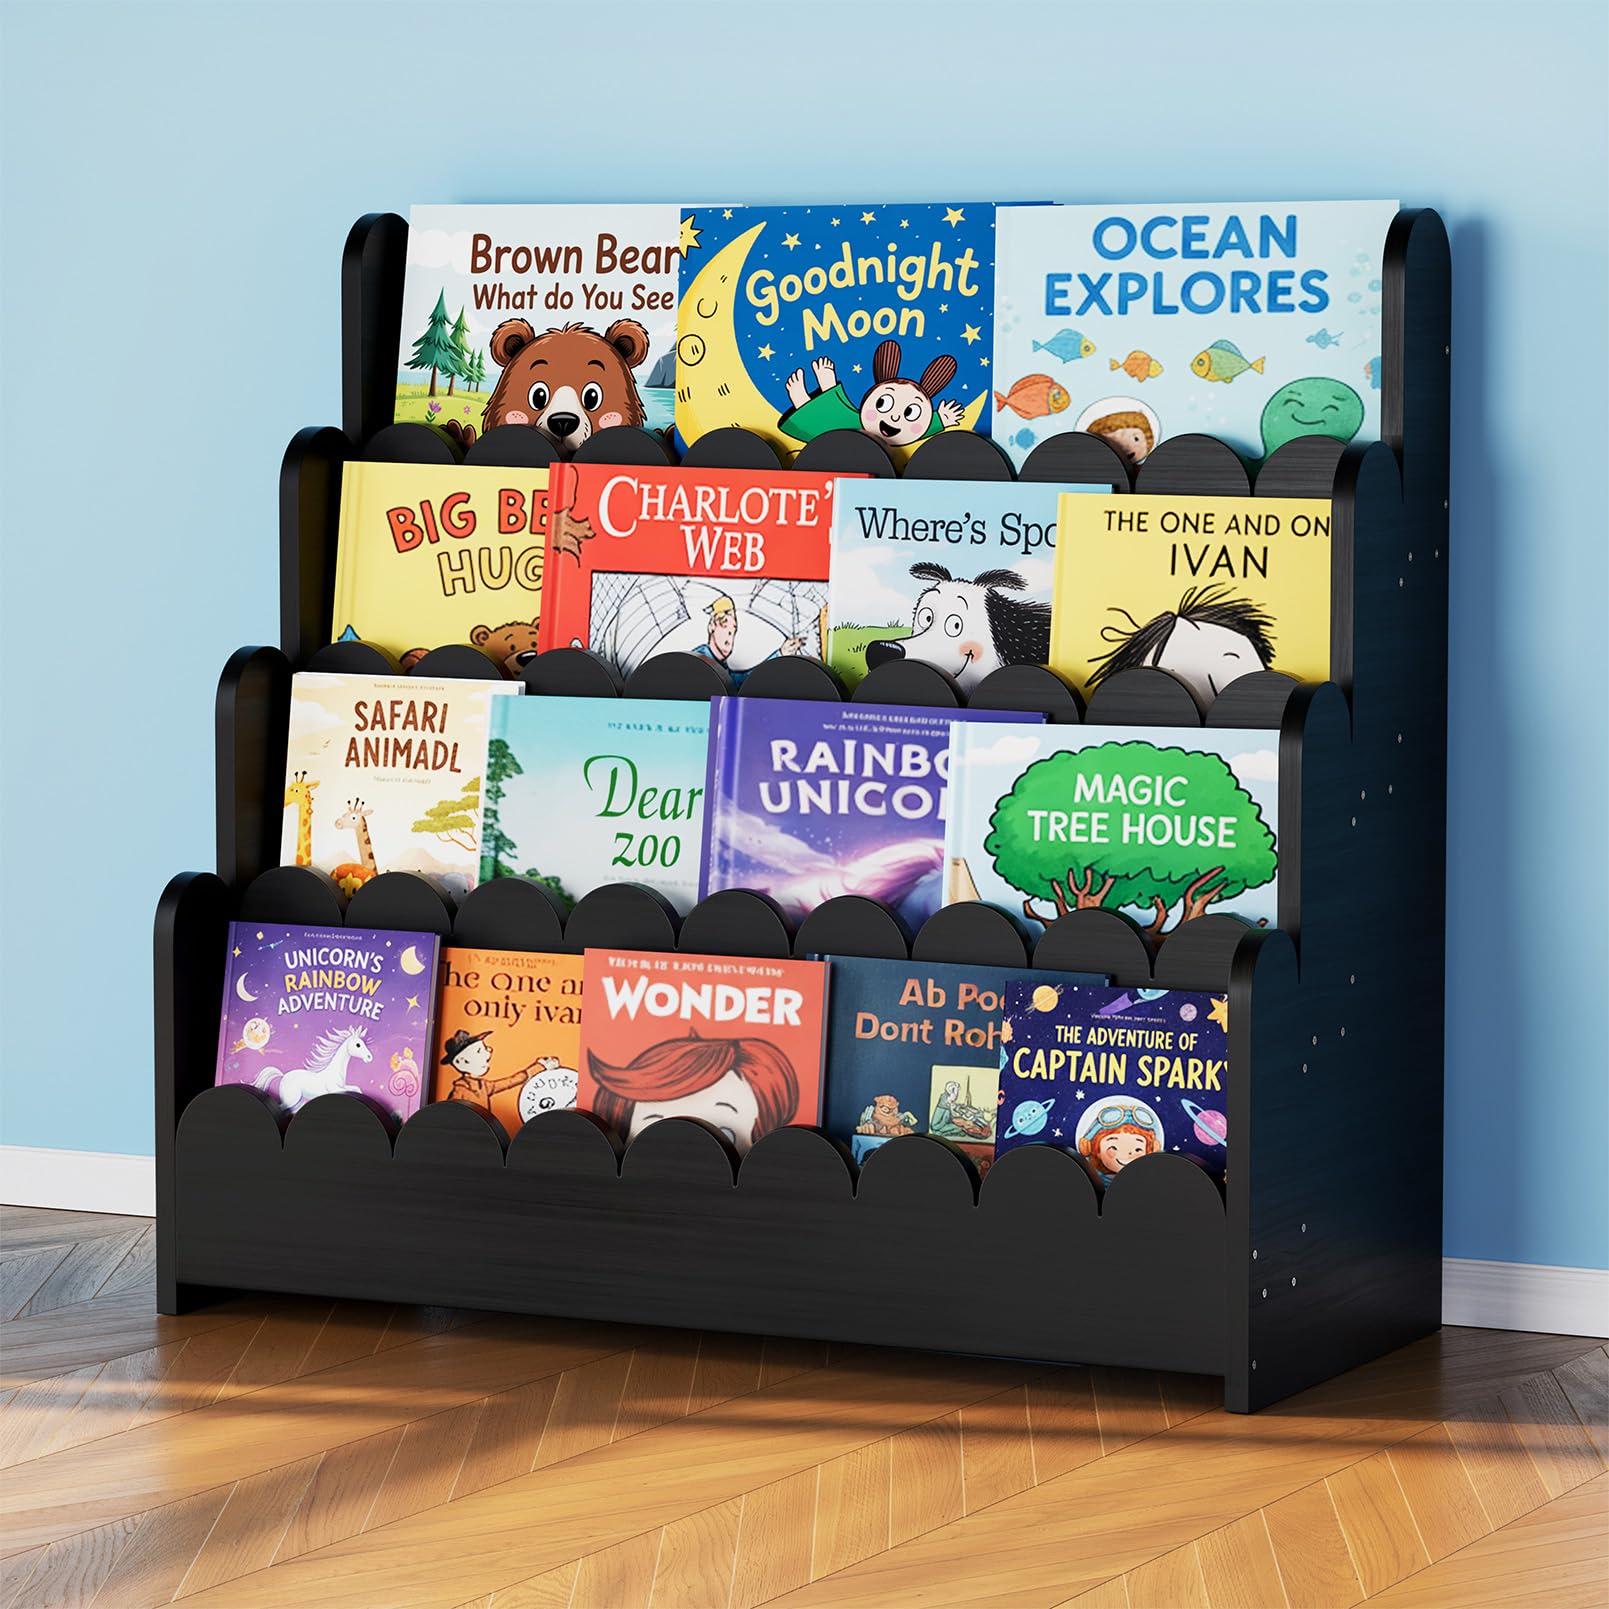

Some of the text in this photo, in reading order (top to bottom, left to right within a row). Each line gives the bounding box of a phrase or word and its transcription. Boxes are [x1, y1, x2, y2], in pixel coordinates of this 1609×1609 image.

[470, 233, 679, 274] Brown Bear
[1092, 214, 1297, 260] OCEAN
[473, 283, 674, 310] What do You See
[746, 242, 979, 325] Goodnight
[1045, 269, 1330, 316] EXPLORES
[803, 303, 925, 350] Moon
[386, 492, 477, 553] BIG
[855, 507, 986, 545] Where's
[1104, 510, 1330, 537] THE ONE AND ON
[680, 525, 766, 571] WEB
[1171, 543, 1268, 578] IVAN
[437, 546, 544, 596] HUG
[354, 700, 448, 734] SAFARI
[345, 737, 462, 773] ANIMADL
[583, 755, 703, 821] Dear
[1073, 773, 1188, 807] MAGIC
[1027, 810, 1238, 848] TREE HOUSE
[284, 948, 384, 973] UNICORN'S
[285, 970, 382, 997] RAINBOW
[601, 975, 803, 1026] WONDER
[899, 978, 1005, 1012] Ab Po
[278, 992, 384, 1021] ADVENTURE
[855, 1012, 933, 1045] Dont
[1055, 1025, 1198, 1051] THE ADVENTURE OF
[1013, 1047, 1228, 1091] CAPTAIN SPARK
